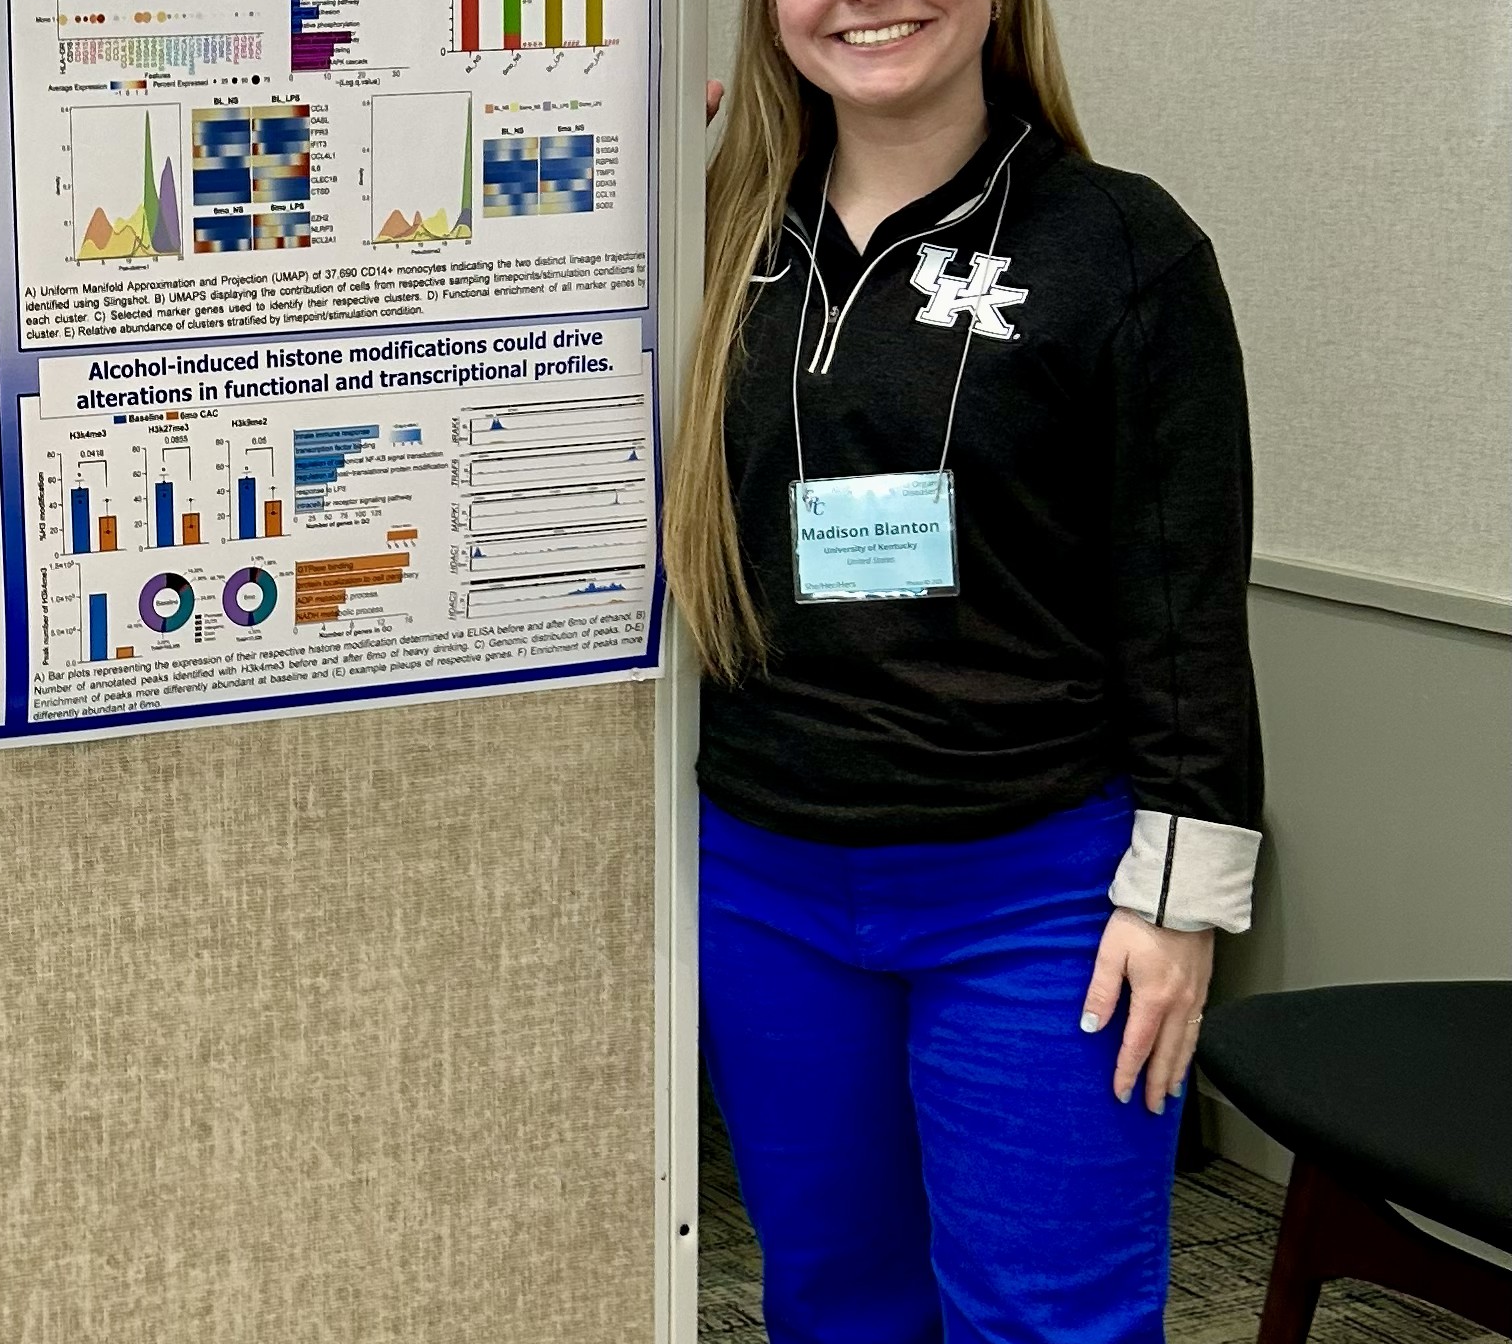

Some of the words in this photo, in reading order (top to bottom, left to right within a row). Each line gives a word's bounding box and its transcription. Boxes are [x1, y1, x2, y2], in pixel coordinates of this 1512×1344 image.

[88, 350, 259, 381] Alcohol-induced
[266, 348, 343, 369] histone
[349, 337, 488, 363] modifications
[492, 330, 547, 353] could
[552, 328, 603, 346] drive
[76, 385, 193, 410] alterations
[198, 381, 218, 401] in
[223, 373, 329, 399] functional
[335, 369, 374, 392] and
[379, 358, 528, 388] transcriptional
[534, 354, 614, 381] profiles.
[801, 525, 870, 541] Madison
[874, 521, 941, 537] Blanton
[823, 545, 866, 555] University
[867, 544, 877, 552] of
